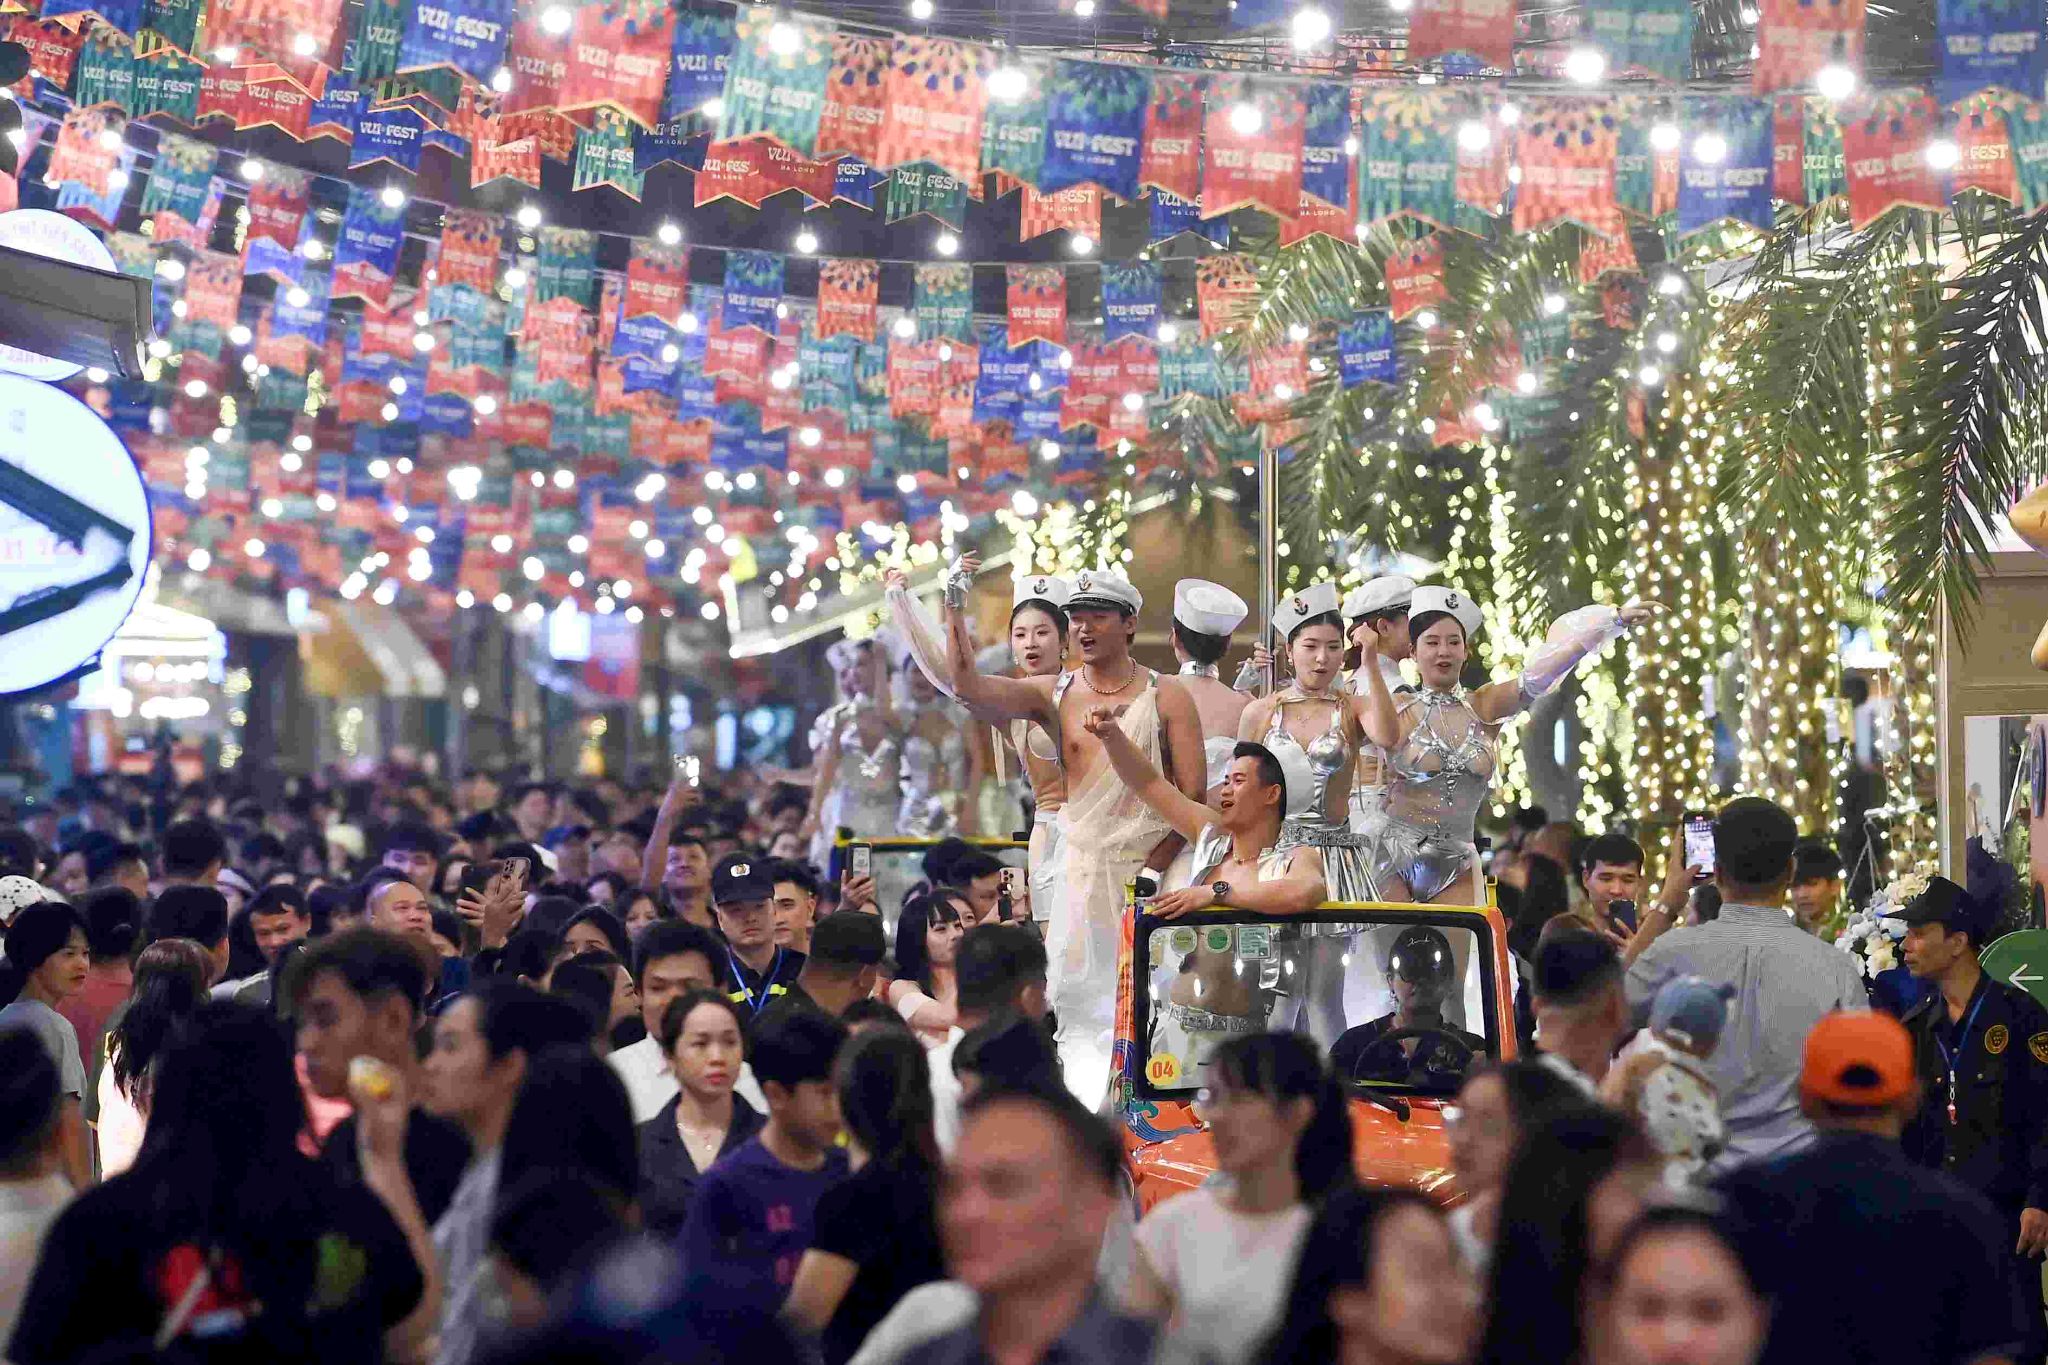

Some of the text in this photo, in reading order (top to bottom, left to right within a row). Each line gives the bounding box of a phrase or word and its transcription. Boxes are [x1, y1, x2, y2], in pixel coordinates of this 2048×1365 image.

[418, 4, 499, 41] VUI FEST
[367, 25, 398, 45] VUI
[1988, 33, 2039, 52] FEST
[41, 42, 72, 56] FEST
[516, 56, 544, 75] VUI
[578, 46, 661, 78] VUI FEST
[677, 55, 707, 71] VUI
[109, 69, 132, 82] FES
[138, 78, 195, 94] VUI FEST
[220, 81, 244, 92] FES
[248, 84, 306, 106] VUI FEST
[329, 90, 359, 102] FEST
[771, 87, 816, 109] FEST
[847, 106, 884, 124] FEST
[360, 121, 418, 140] VUI FEST
[1000, 125, 1041, 142] FEST
[584, 144, 633, 161] VUI FES
[1091, 135, 1137, 155] FEST
[1152, 139, 1192, 154] FEST
[1775, 145, 1797, 160] ST
[1970, 144, 2008, 159] FEST
[768, 147, 792, 161] VUI
[1251, 152, 1295, 172] FEST
[726, 160, 750, 173] FES
[838, 164, 867, 175] FEST
[897, 171, 959, 190] VUI FEST
[1723, 169, 1767, 186] FEST
[1060, 190, 1095, 203] FEST
[751, 298, 777, 308] FEST
[1130, 304, 1156, 314] FEST
[1033, 309, 1061, 319] FEST
[1152, 1062, 1174, 1079] 04
